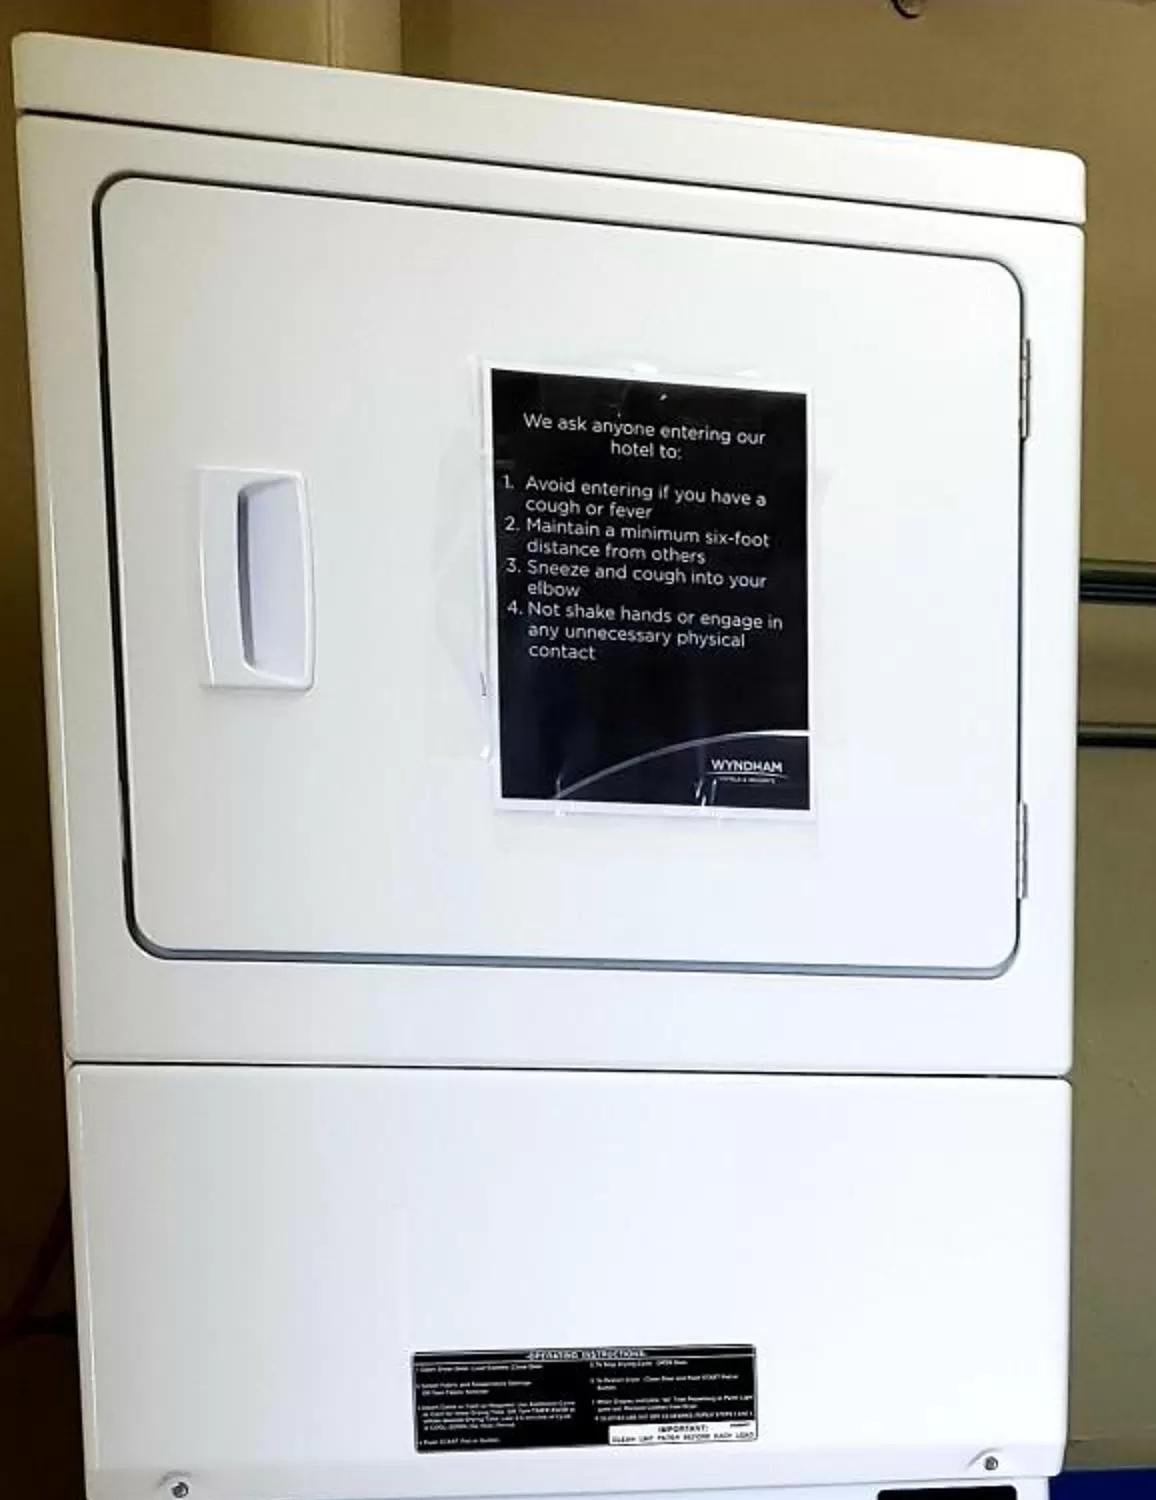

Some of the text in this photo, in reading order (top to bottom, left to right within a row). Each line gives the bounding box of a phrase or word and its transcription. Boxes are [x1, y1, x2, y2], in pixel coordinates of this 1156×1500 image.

[524, 412, 765, 445] We ask anyone entering our
[611, 440, 683, 460] hotel to:
[503, 475, 767, 506] 1. Avoid entering if you have a
[525, 499, 653, 519] cough or fever
[504, 516, 769, 548] 2. Maintain a minimum six-foot
[527, 538, 706, 564] distance from others
[505, 557, 767, 590] 3. Sneeze and cough into your
[527, 581, 581, 598] elbow
[507, 600, 783, 631] 4. Not shake hands or engage in
[528, 623, 746, 649] any unnecessary physical
[529, 645, 597, 661] contact
[711, 759, 783, 772] WYNDHAM
